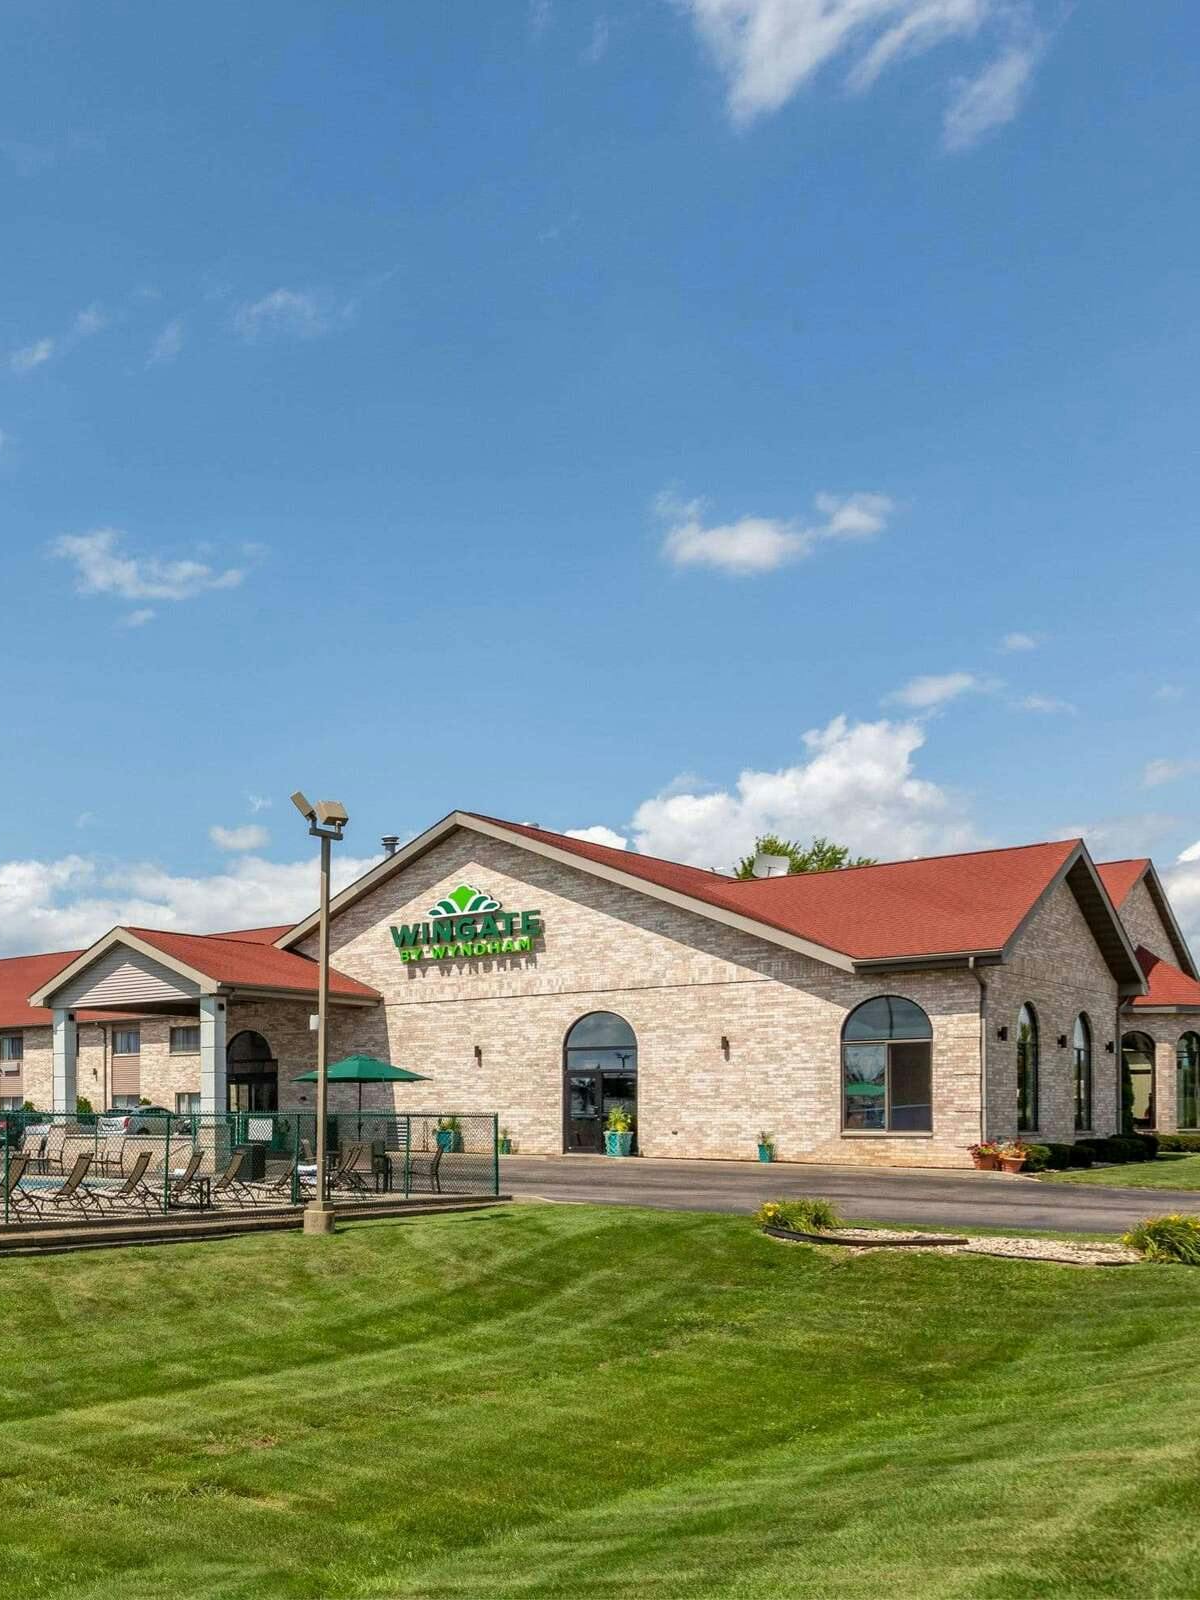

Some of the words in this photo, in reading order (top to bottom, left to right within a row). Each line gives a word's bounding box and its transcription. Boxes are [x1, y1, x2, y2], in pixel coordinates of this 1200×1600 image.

[390, 910, 541, 947] WINGATE
[401, 949, 423, 963] BY
[432, 937, 533, 960] WYNDHAM
